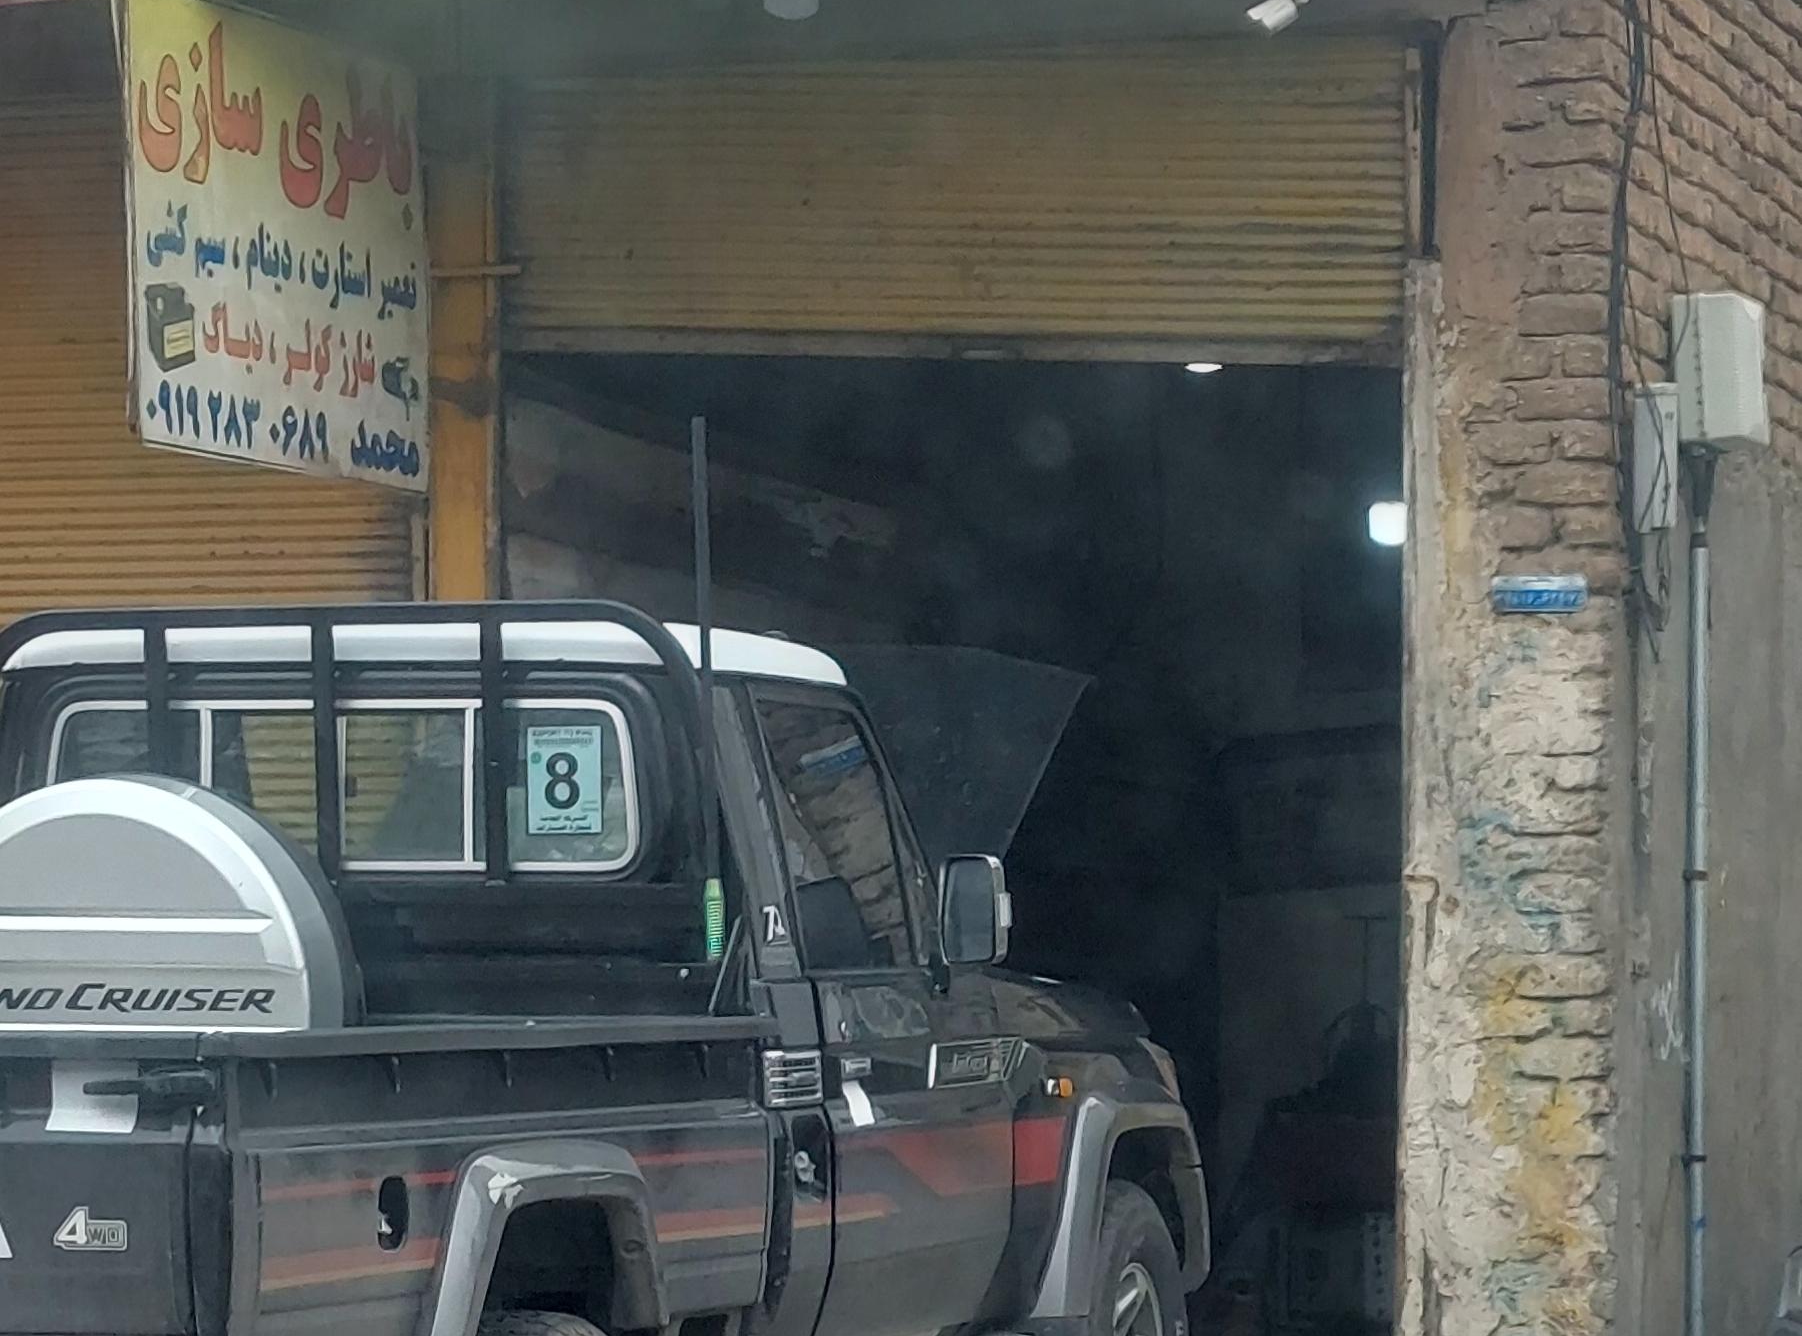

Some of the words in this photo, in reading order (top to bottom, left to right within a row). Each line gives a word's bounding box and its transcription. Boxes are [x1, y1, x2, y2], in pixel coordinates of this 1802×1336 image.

[139, 21, 263, 184] سازی
[279, 62, 414, 231] باطری
[195, 237, 226, 278] سیم
[246, 222, 292, 292] دینام
[312, 240, 371, 309] استارت
[377, 262, 417, 320] تعمیر
[351, 418, 420, 477] محمد
[544, 752, 580, 810] 8
[65, 983, 275, 1013] CRUISER
[57, 1209, 124, 1245] 4WD
